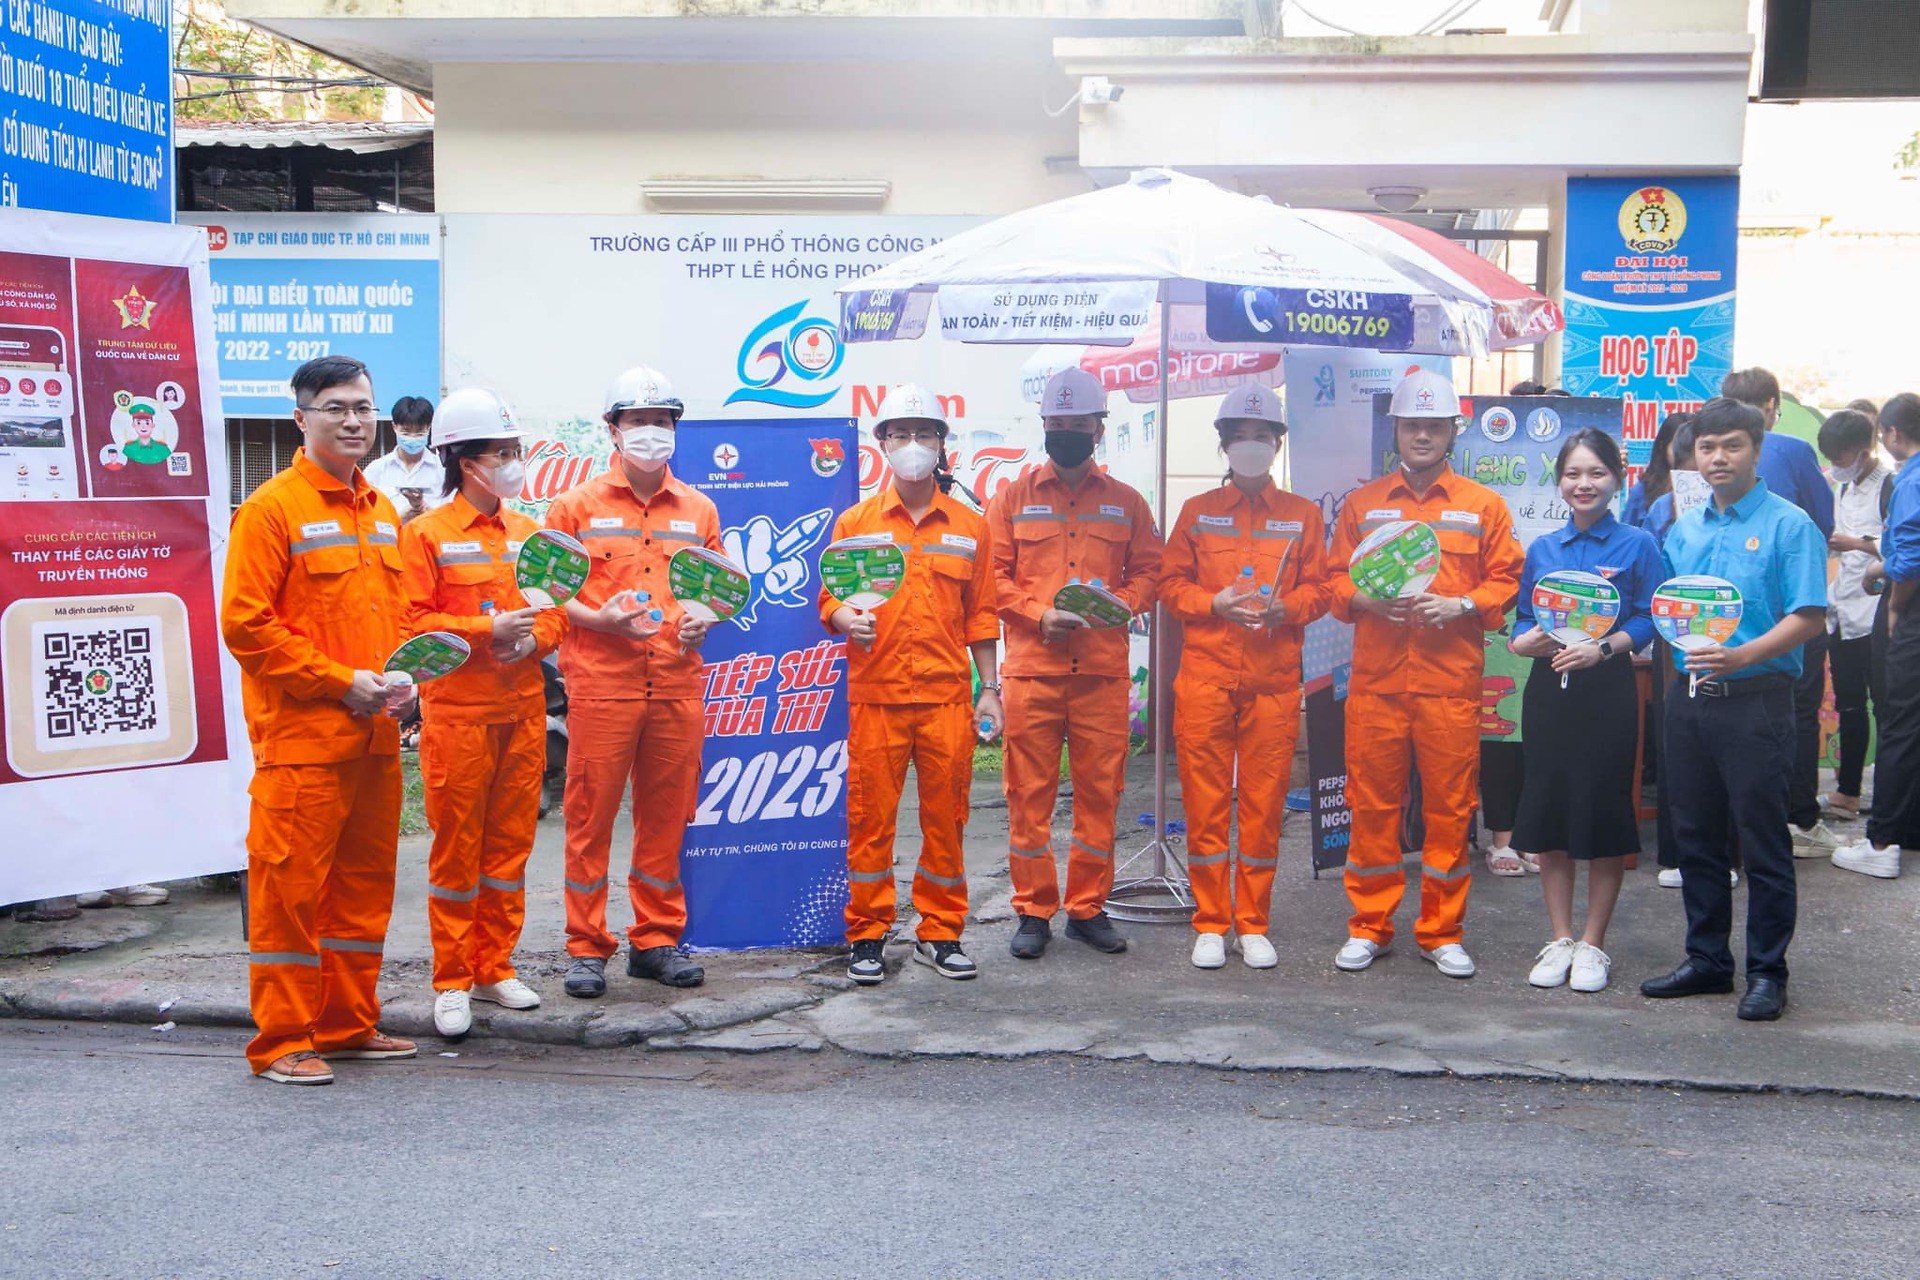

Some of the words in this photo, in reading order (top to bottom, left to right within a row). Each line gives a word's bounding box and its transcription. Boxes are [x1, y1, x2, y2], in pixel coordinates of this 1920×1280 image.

[34, 0, 64, 49] HÀNH
[66, 14, 77, 53] VI
[79, 20, 99, 60] SAU
[101, 21, 123, 67] ĐÂY:
[17, 53, 46, 103] DƯỚI
[48, 68, 62, 107] 18
[64, 62, 91, 116] TUỔI
[93, 72, 118, 123] ĐIỀU
[120, 82, 151, 134] KHIỂN
[154, 102, 166, 137] XE
[3, 109, 18, 157] CÓ
[20, 121, 50, 165] DUNG
[51, 122, 75, 171] TÍCH
[77, 136, 87, 174] XI
[89, 140, 115, 181] LANH
[117, 141, 129, 184] TỪ
[131, 151, 142, 187] 50
[233, 232, 254, 247] TẠP
[312, 232, 335, 248] DỤC
[339, 232, 353, 245] TP.
[400, 232, 430, 246] MINH
[590, 232, 671, 252] TRƯỜNG
[676, 231, 716, 251] CẤP
[722, 238, 737, 251] III
[744, 230, 785, 252] PHỔ
[794, 233, 860, 252] THÔNG
[866, 234, 924, 252] CÔNG
[686, 264, 735, 278] THPT
[742, 261, 766, 278] LÊ
[772, 258, 828, 279] HỒNG
[1615, 257, 1649, 269] ĐẠI
[1653, 255, 1688, 269] HỘI
[233, 285, 263, 308] ĐẠI
[268, 278, 308, 305] BIỂU
[313, 282, 360, 306] TOÀN
[364, 279, 413, 307] QUỐC
[1306, 288, 1369, 311] CSKH
[241, 312, 288, 333] MINH
[293, 307, 325, 333] LẦN
[330, 311, 366, 334] THỨ
[369, 314, 394, 334] XII
[942, 317, 958, 329] AN
[963, 313, 999, 328] TOÀN
[1012, 311, 1035, 328] TIẾT
[1040, 313, 1073, 330] KIỆM
[1085, 311, 1115, 329] HIỆU
[1284, 311, 1390, 337] 19006769
[98, 339, 126, 348] TRUNG
[224, 340, 270, 361] 2022
[286, 341, 331, 361] 2027
[95, 348, 120, 359] QUỐC
[148, 352, 166, 361] DÂN
[167, 353, 181, 361] CƯ
[1602, 337, 1647, 385] HỌC
[1653, 330, 1697, 385] TẬP
[852, 385, 966, 418] Nm
[1621, 392, 1657, 440] ÀM
[1519, 501, 1537, 519] về
[24, 533, 58, 543] CUNG
[61, 530, 83, 542] CẤP
[86, 530, 109, 541] CÁC
[112, 529, 135, 542] TIỆN
[137, 529, 157, 540] ÍCH
[12, 550, 50, 563] THAY
[54, 545, 82, 561] THẾ
[85, 546, 114, 561] CÁC
[117, 543, 149, 560] GIẤY
[152, 545, 171, 558] TỜ
[38, 567, 95, 582] TRUYỀN
[98, 563, 148, 579] THỐNG
[55, 607, 68, 615] Mã
[69, 606, 86, 615] định
[87, 604, 107, 613] danh
[108, 603, 124, 613] điện
[700, 652, 775, 699] TIẾP
[776, 640, 848, 692] SỨC
[772, 689, 834, 734] THI
[690, 740, 848, 826] 2023
[1318, 774, 1348, 791] PEPSI
[1320, 790, 1346, 809] KHÔ
[686, 847, 706, 857] HÃY
[709, 847, 723, 858] TỰ
[725, 845, 741, 855] TIN,
[744, 841, 777, 853] CHÚNG
[781, 840, 797, 850] TÔI
[799, 840, 808, 850] ĐI
[812, 838, 838, 849] CÙNG
[1323, 828, 1350, 850] SỐN
